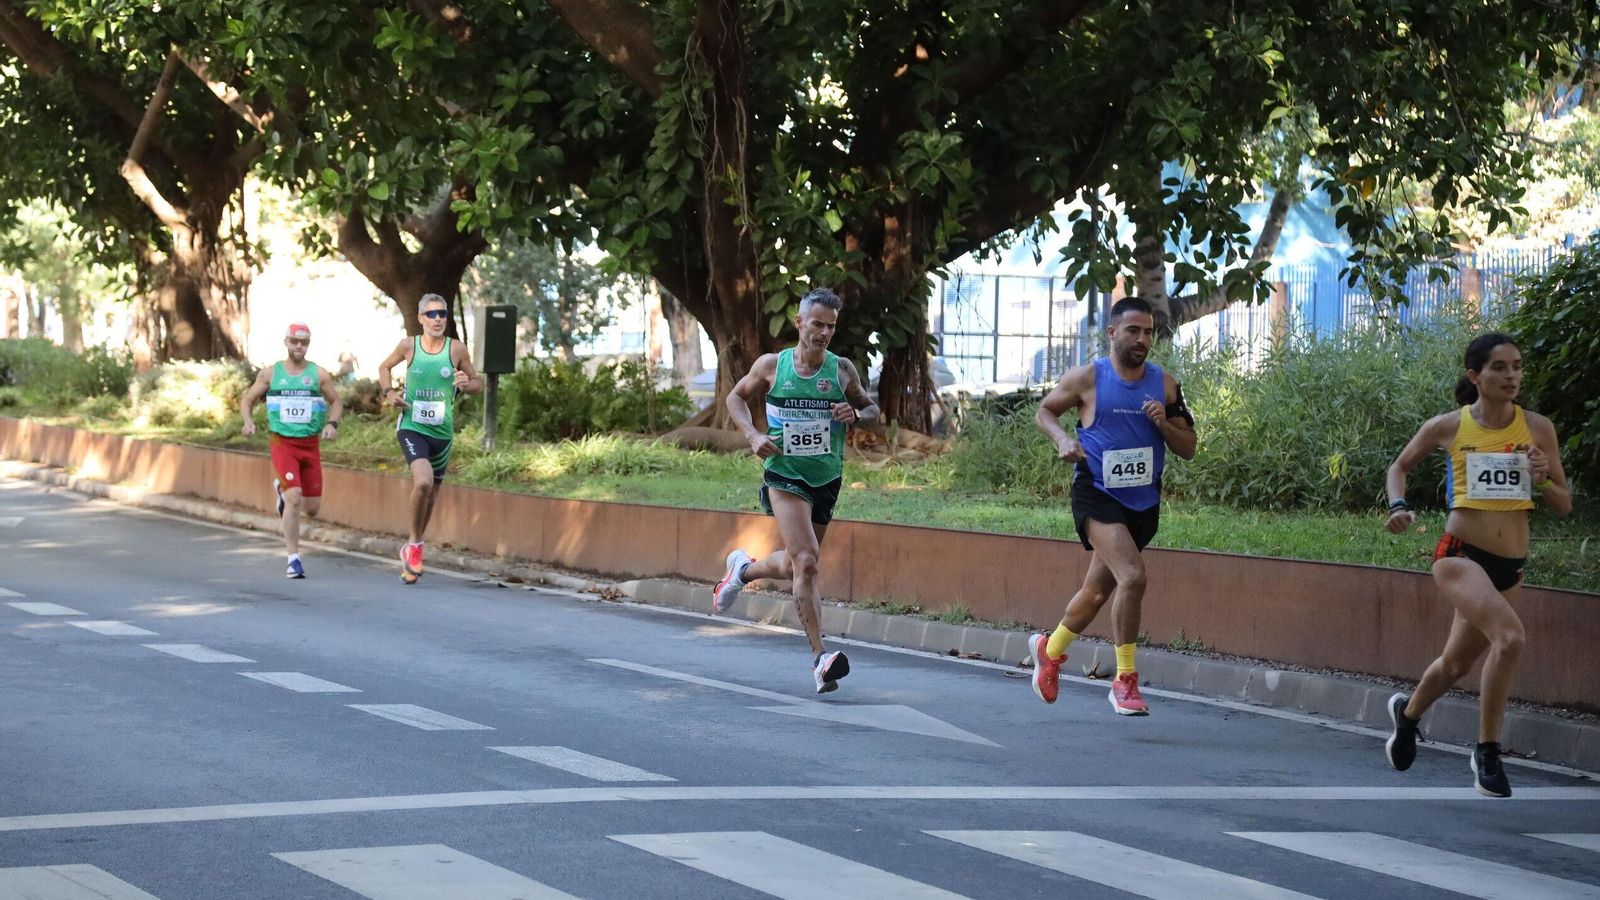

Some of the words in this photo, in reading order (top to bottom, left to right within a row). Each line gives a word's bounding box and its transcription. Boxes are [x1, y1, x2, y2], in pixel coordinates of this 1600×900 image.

[415, 387, 445, 399] mijas
[784, 399, 829, 409] ATLETISMO
[284, 407, 306, 416] 107
[420, 409, 436, 418] 90
[778, 409, 833, 419] TORREMOLINO
[791, 433, 823, 446] 365
[1111, 461, 1146, 476] 448
[1477, 469, 1521, 486] 409
